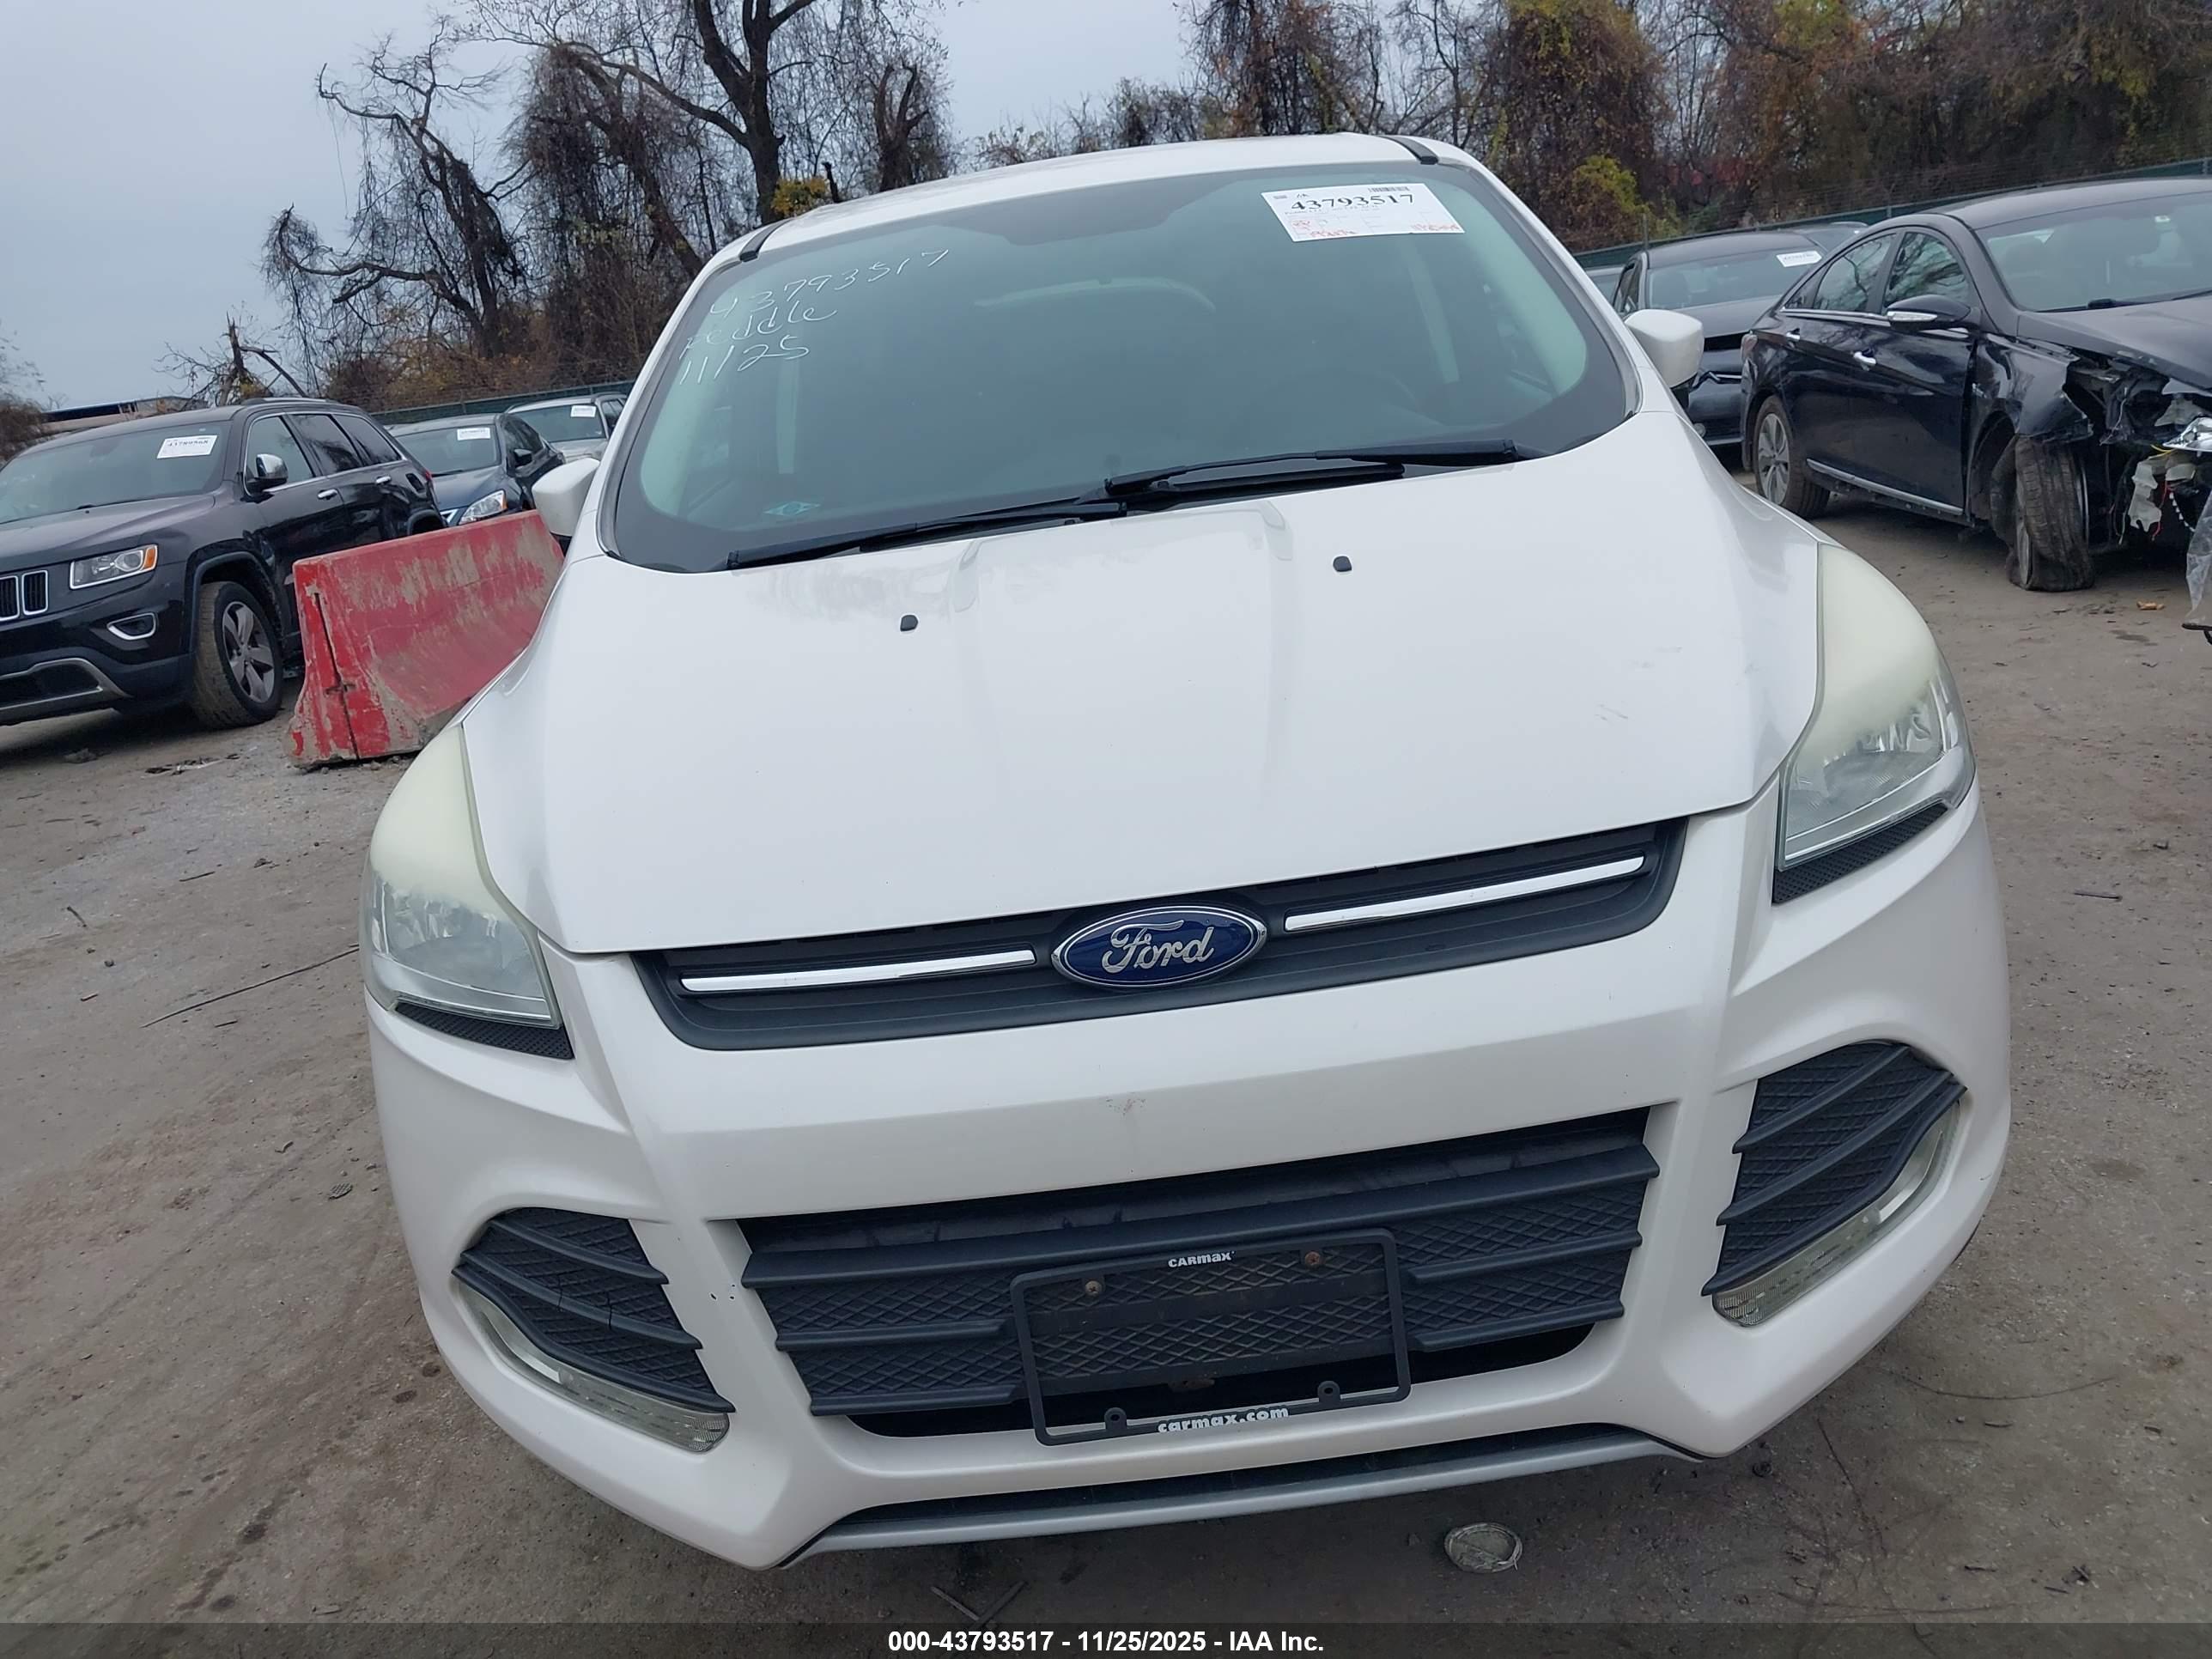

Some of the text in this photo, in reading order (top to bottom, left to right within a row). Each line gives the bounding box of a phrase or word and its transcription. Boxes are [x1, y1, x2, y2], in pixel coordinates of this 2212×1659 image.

[1291, 194, 1413, 211] 43793517
[709, 249, 949, 319] 43793517
[679, 335, 809, 386] 11/25
[1102, 920, 1214, 974] Ford
[1158, 1407, 1289, 1433] carmax.com
